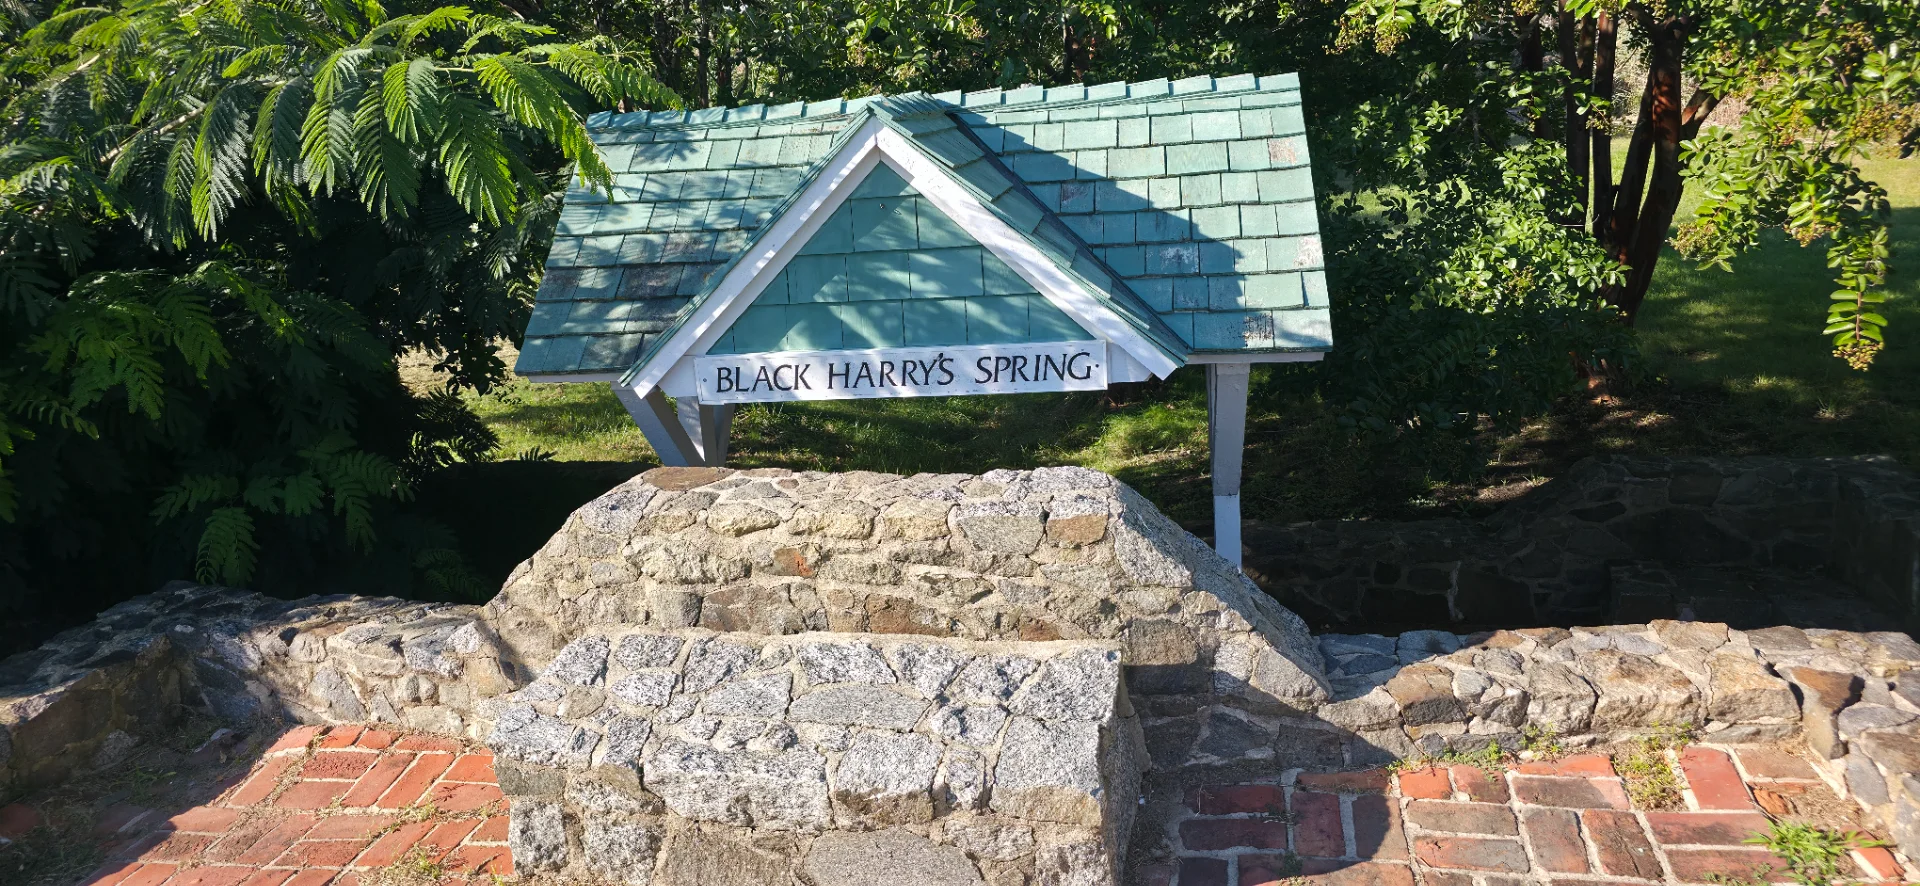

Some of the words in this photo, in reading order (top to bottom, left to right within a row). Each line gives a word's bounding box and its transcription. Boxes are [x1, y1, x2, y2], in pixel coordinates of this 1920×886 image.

[716, 364, 812, 393] BLACK
[827, 352, 954, 389] HARRY'S
[974, 352, 1091, 384] SPRING
